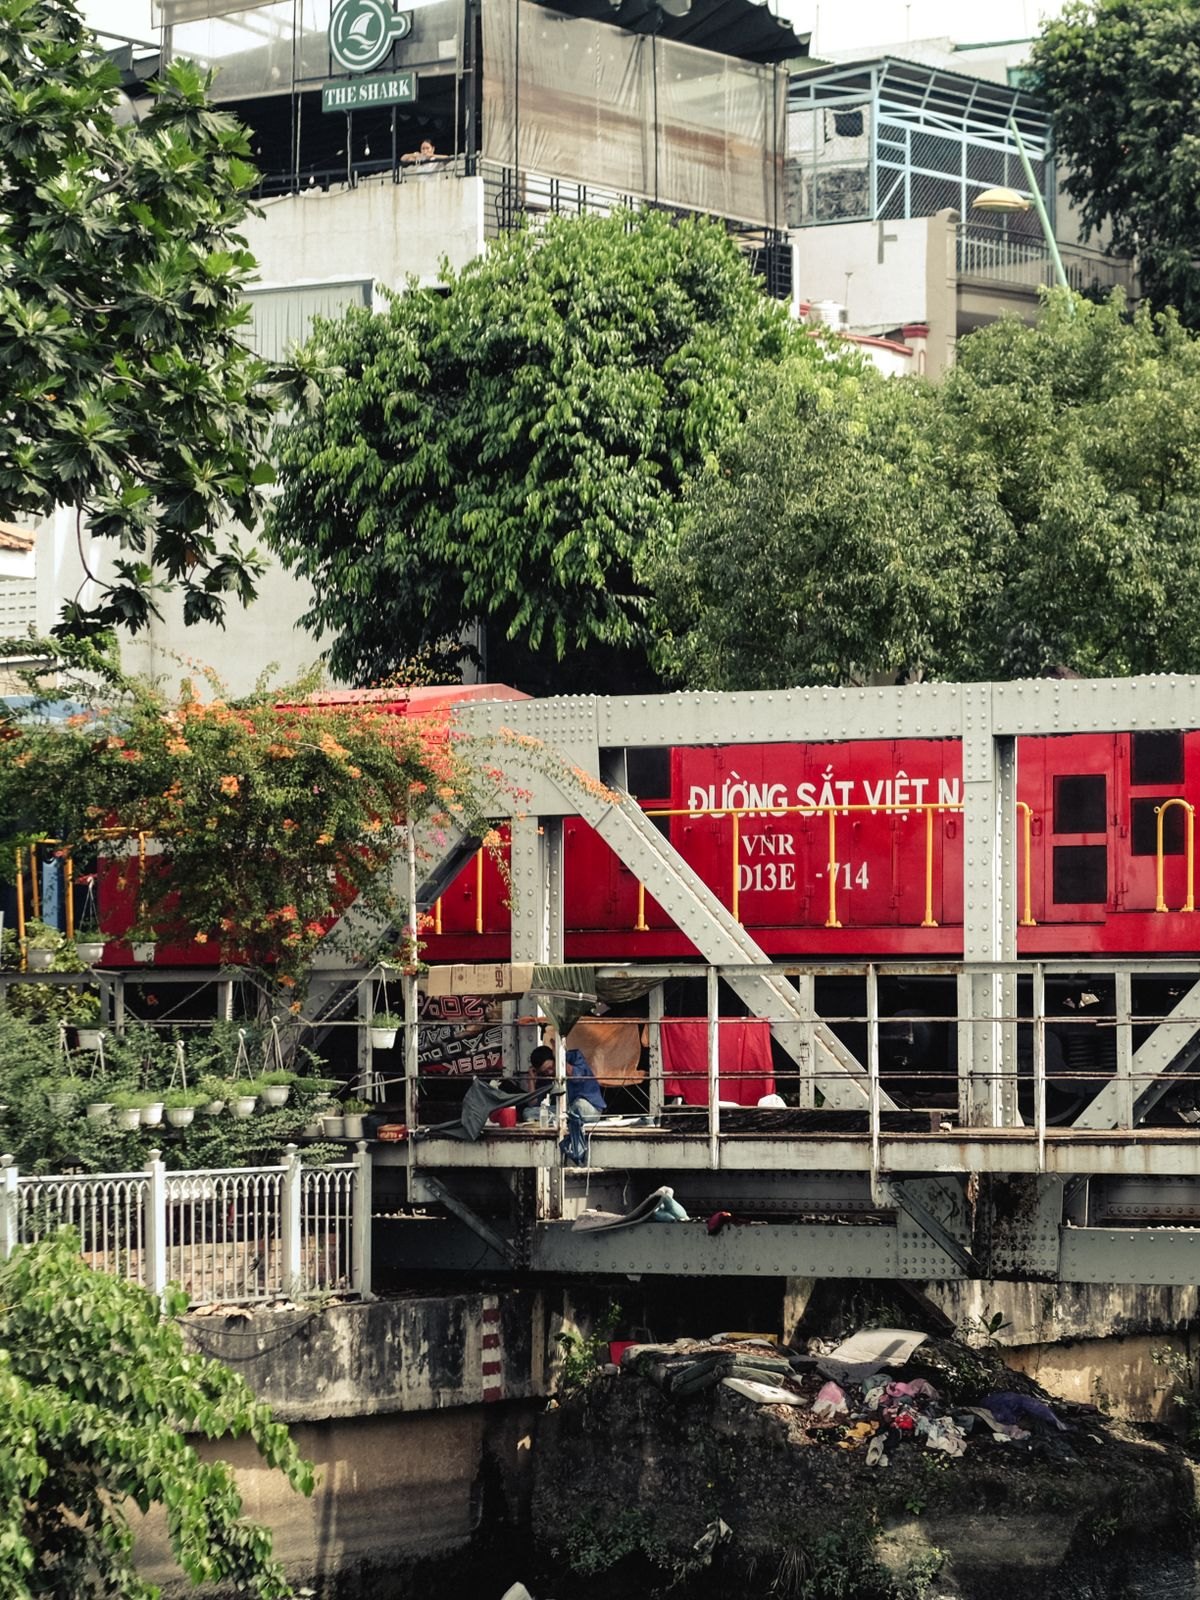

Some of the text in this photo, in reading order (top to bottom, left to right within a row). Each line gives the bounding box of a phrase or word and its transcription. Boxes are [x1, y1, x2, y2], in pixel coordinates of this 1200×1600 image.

[325, 79, 410, 106] THE SHARK
[688, 764, 964, 821] ĐƯỜNG SẮT VIỆT N
[741, 833, 796, 856] VNR
[737, 862, 796, 892] D13E
[443, 1051, 501, 1075] 499K
